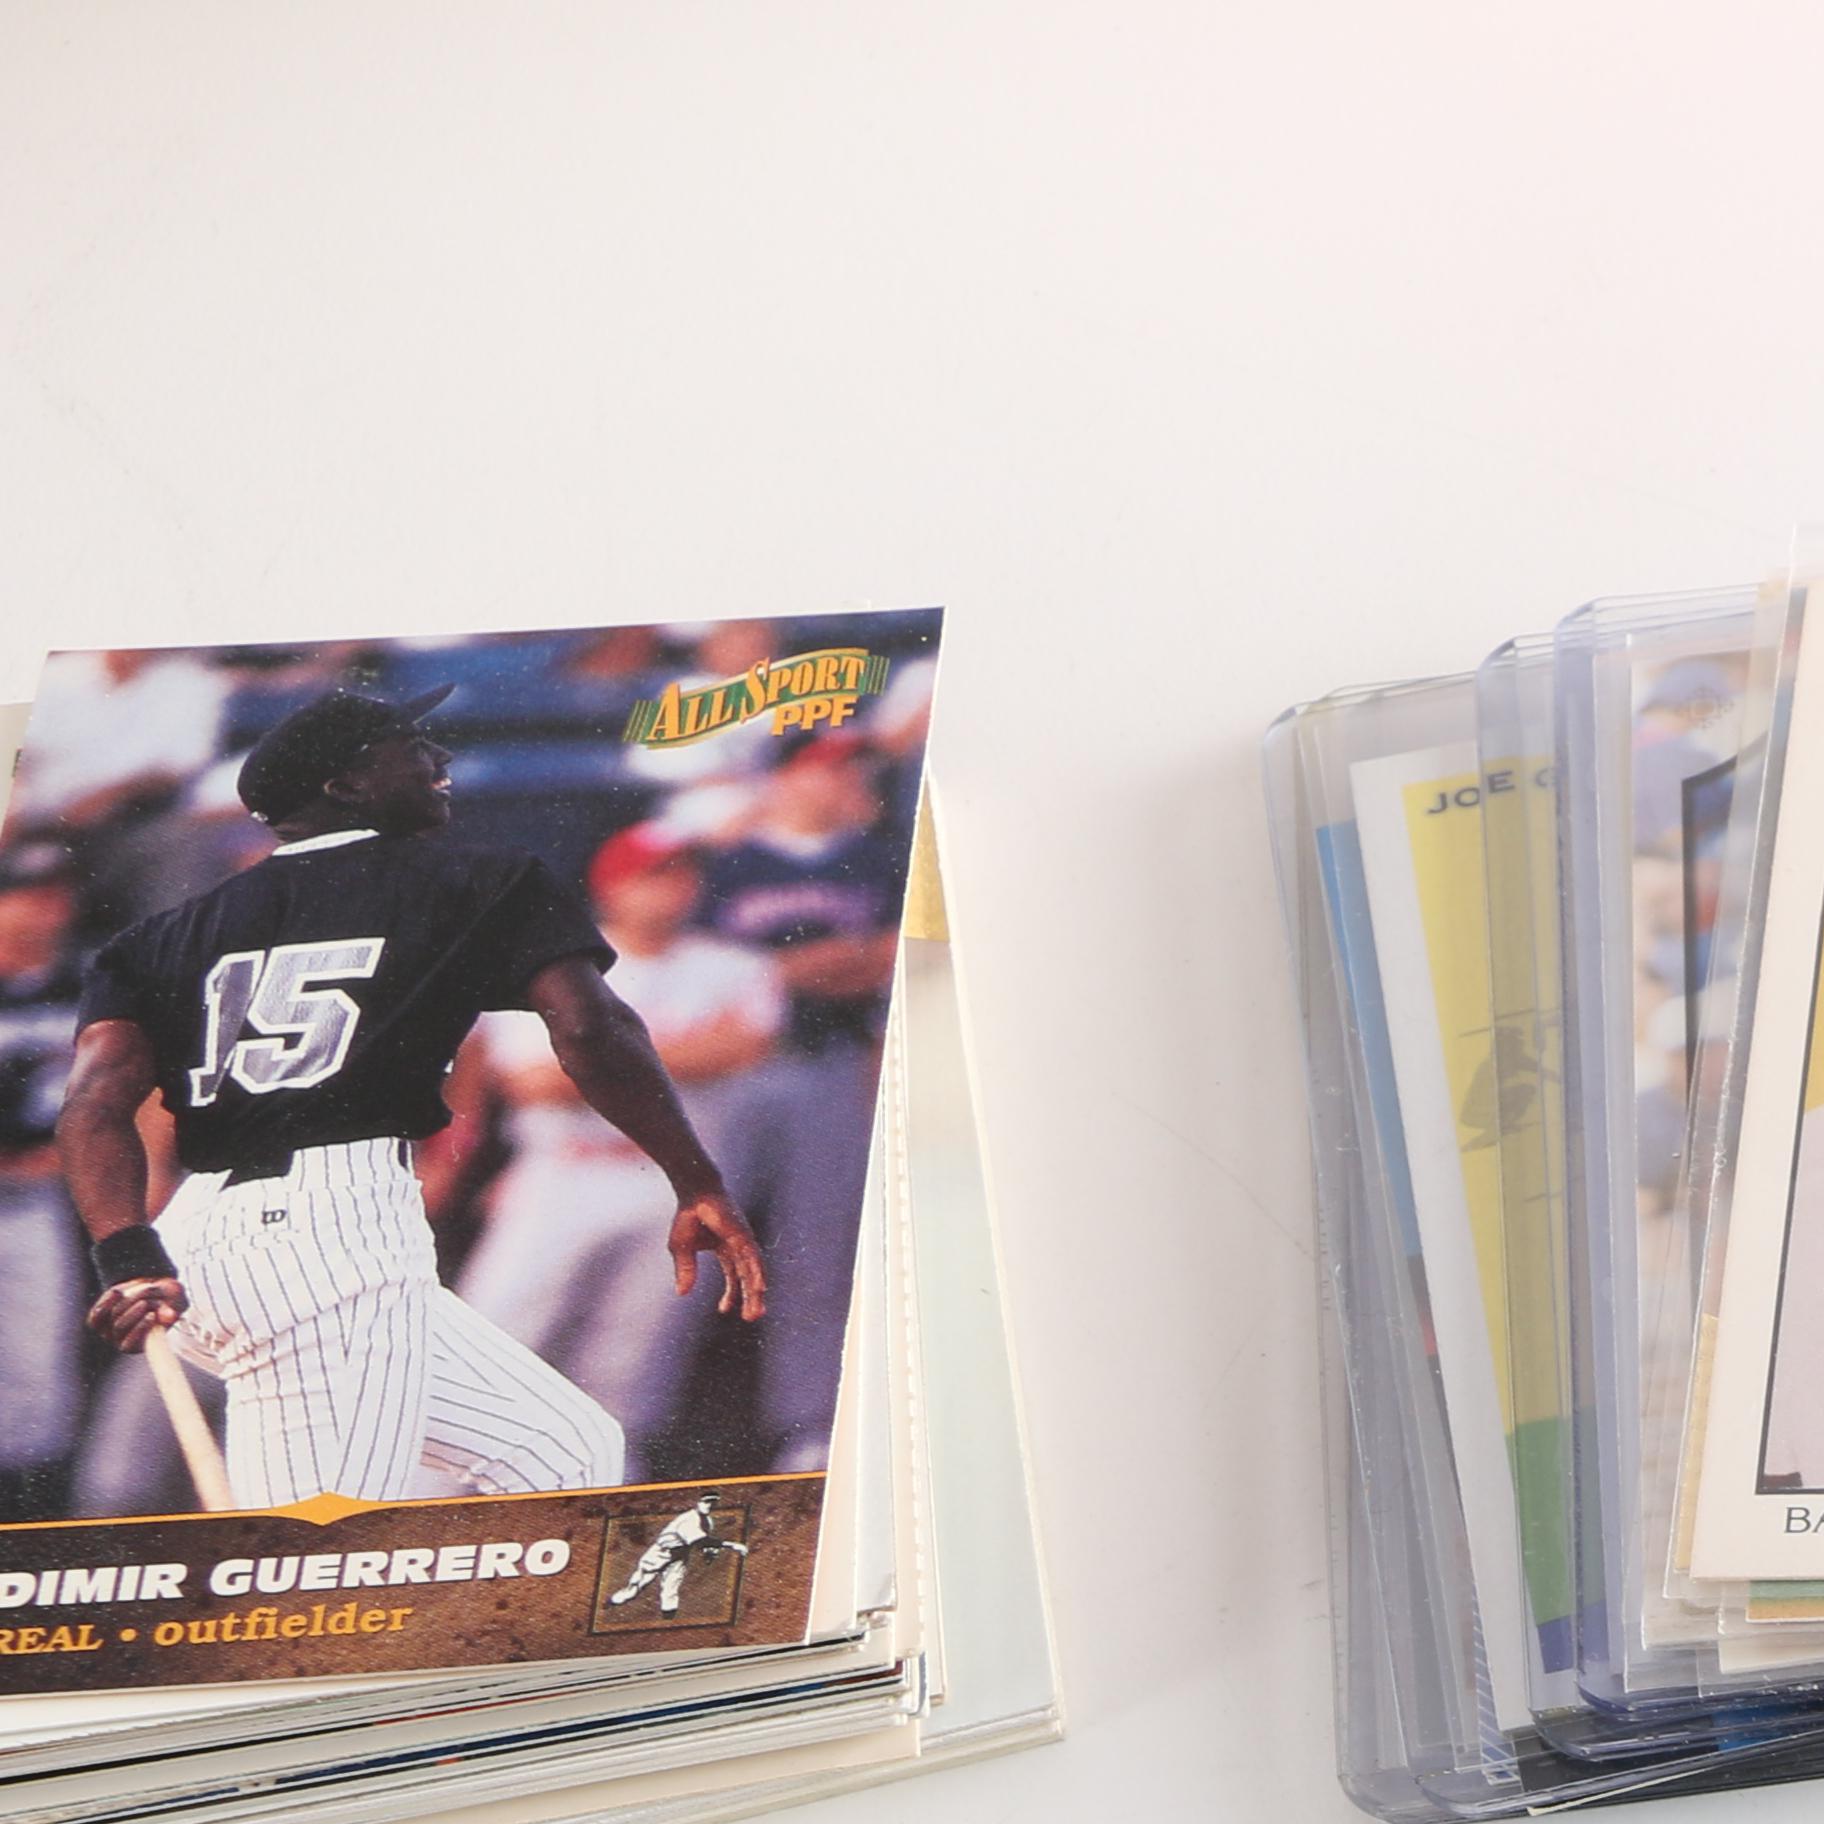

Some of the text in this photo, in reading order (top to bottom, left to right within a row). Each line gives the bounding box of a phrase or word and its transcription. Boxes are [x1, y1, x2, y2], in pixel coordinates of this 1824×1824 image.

[646, 656, 866, 741] ALL SPORT
[771, 695, 859, 736] PPF
[1426, 769, 1516, 815] JOE
[188, 936, 386, 1107] 15
[0, 1538, 572, 1609] DIMIR GUERRERO
[0, 1602, 414, 1655] REAL outfielder
